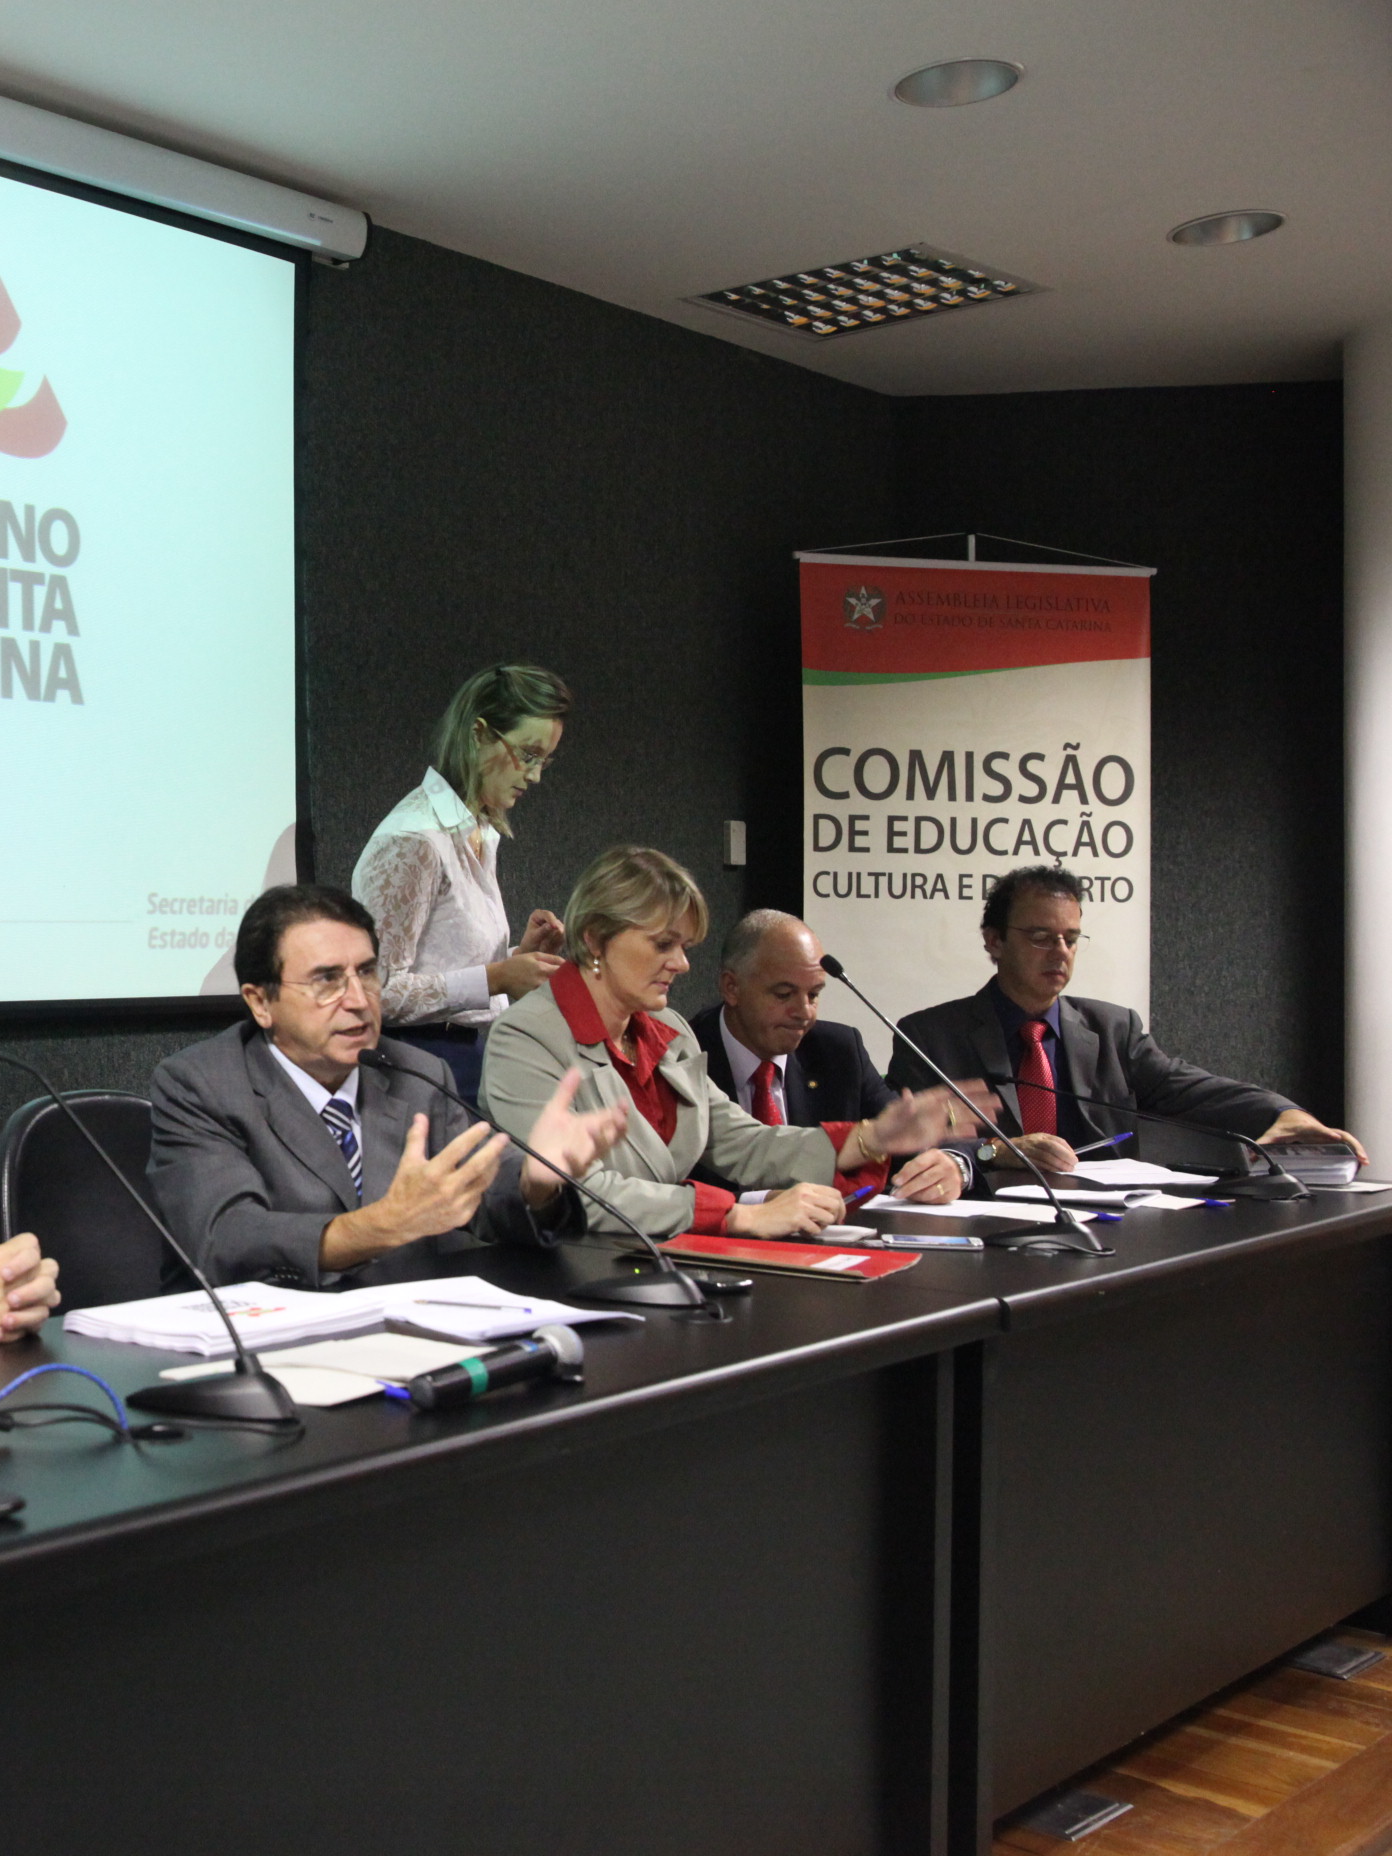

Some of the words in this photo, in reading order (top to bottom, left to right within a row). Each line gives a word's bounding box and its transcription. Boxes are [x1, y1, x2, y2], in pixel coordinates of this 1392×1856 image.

[895, 591, 999, 608] ASSEMBLEIA
[1006, 594, 1111, 613] LEGISLATIVA
[894, 613, 915, 626] DO
[920, 614, 973, 628] ESTADO
[812, 742, 1136, 807] COMISSÃO
[812, 813, 871, 853] DE
[886, 811, 1134, 868] EDUCAÇÃO
[812, 870, 950, 901] CULTURA
[958, 874, 974, 901] E
[147, 892, 238, 916] Secretaria
[148, 926, 210, 950] Estado
